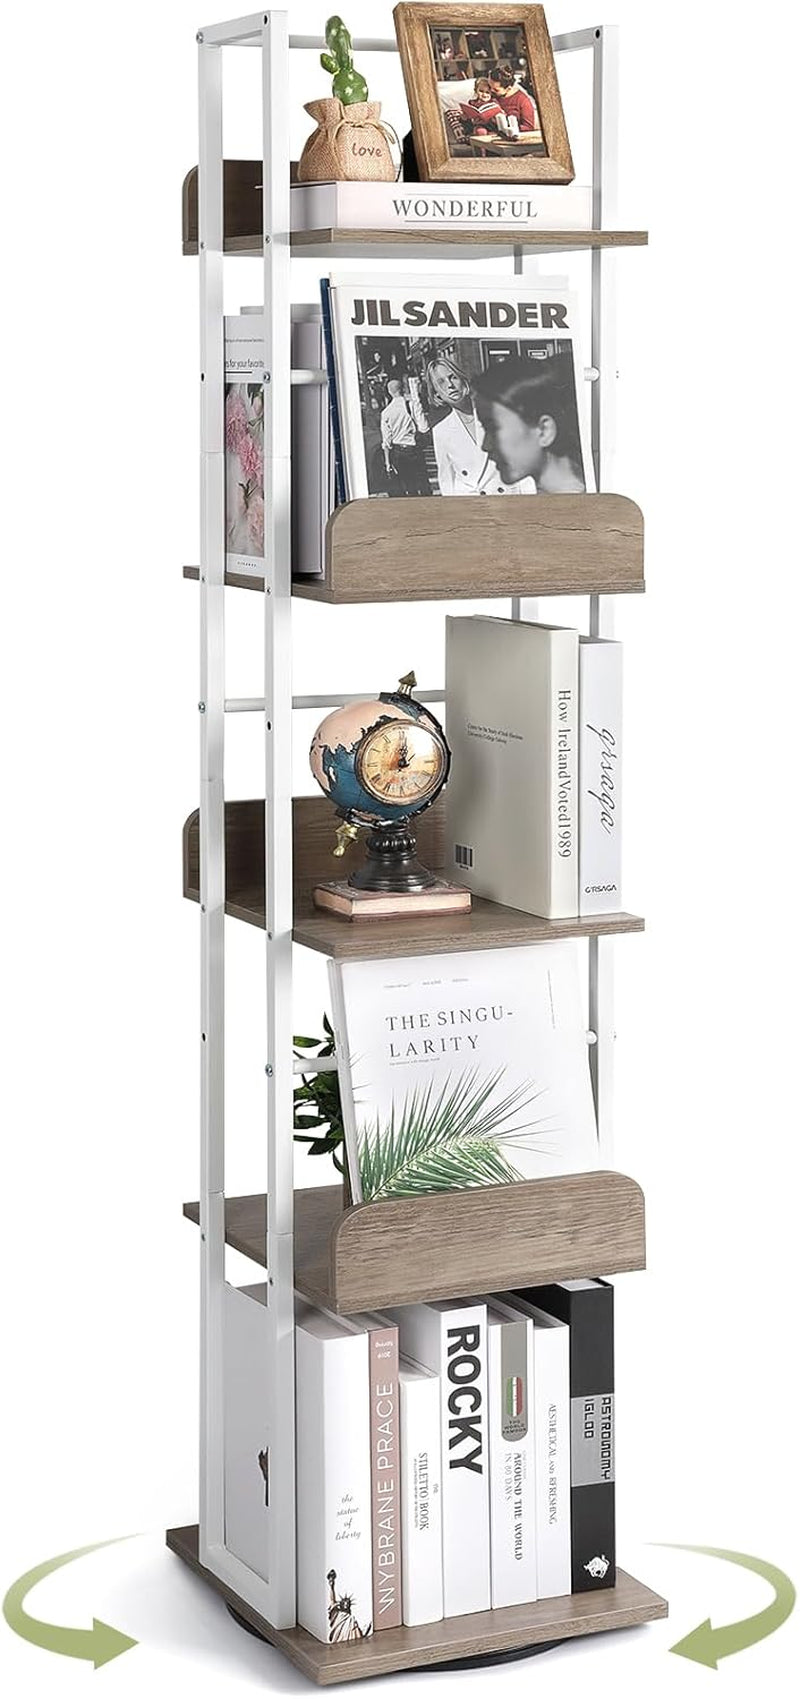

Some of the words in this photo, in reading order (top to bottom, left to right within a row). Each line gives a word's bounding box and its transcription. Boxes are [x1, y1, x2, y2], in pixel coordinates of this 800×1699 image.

[352, 142, 382, 157] love
[392, 199, 538, 218] WONDERFUL
[351, 299, 401, 326] JIL
[402, 300, 570, 328] SANDER
[558, 690, 571, 722] How
[385, 1013, 431, 1031] THE
[437, 1005, 513, 1026] SINGU-
[389, 1035, 478, 1058] LARITY
[447, 1324, 483, 1475] ROCKY
[376, 1383, 395, 1470] PRACE
[419, 1452, 429, 1499] STILETTO
[513, 1452, 522, 1496] AROUND
[419, 1502, 429, 1530] BOOK
[514, 1499, 522, 1520] THE
[377, 1479, 396, 1615] WYBRANE
[514, 1522, 522, 1560] WORLD
